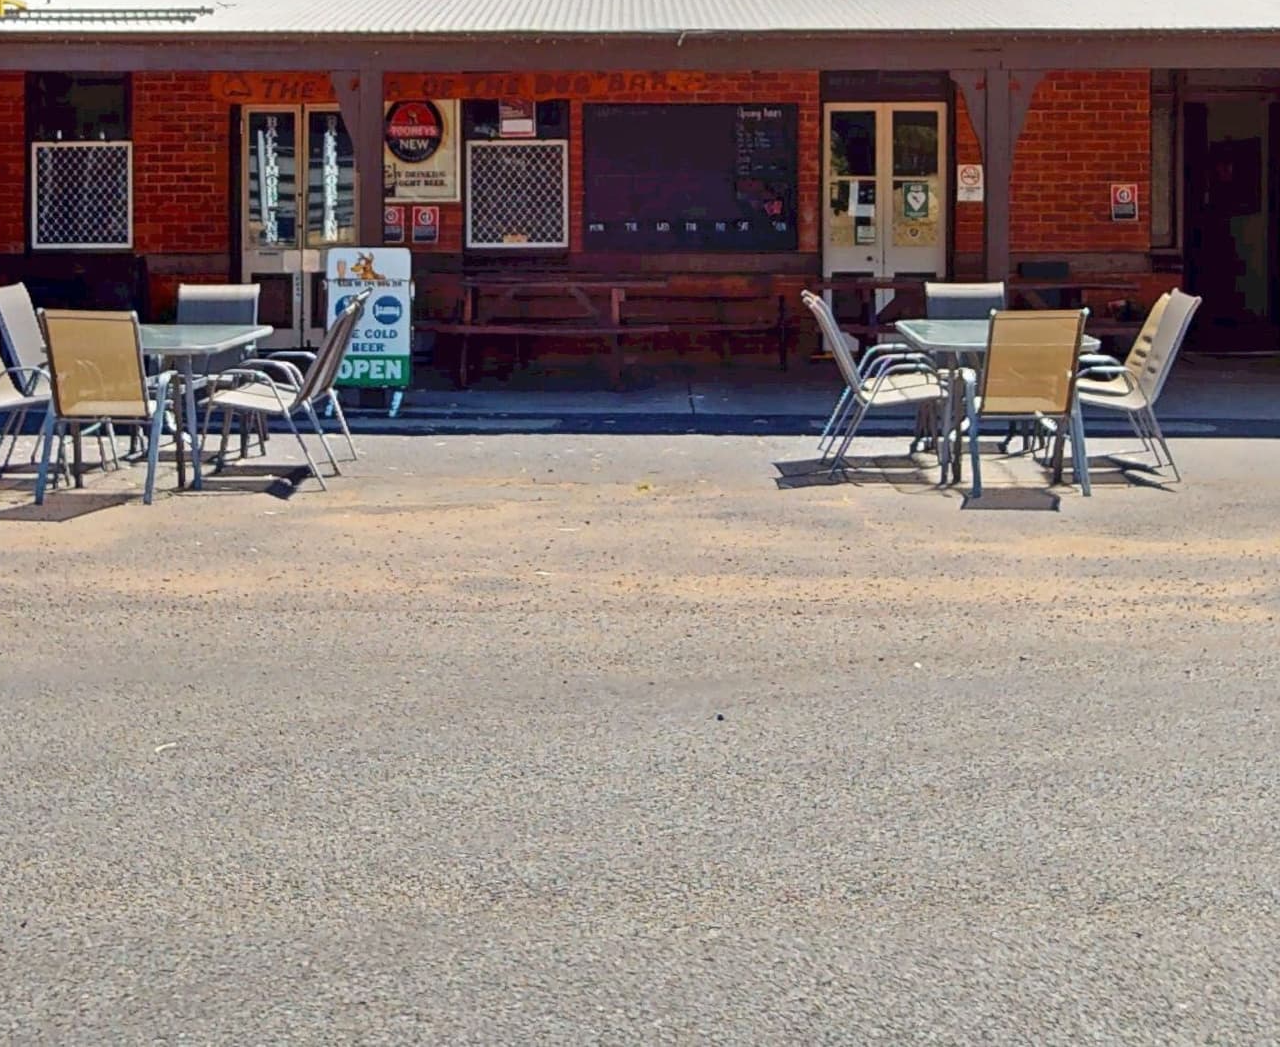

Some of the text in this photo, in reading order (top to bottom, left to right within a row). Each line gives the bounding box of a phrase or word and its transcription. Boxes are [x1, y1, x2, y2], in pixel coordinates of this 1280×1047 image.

[262, 76, 317, 99] THE
[399, 139, 430, 150] NEW
[364, 329, 398, 339] COLD
[352, 342, 385, 352] BEER
[338, 359, 402, 380] OPEN
